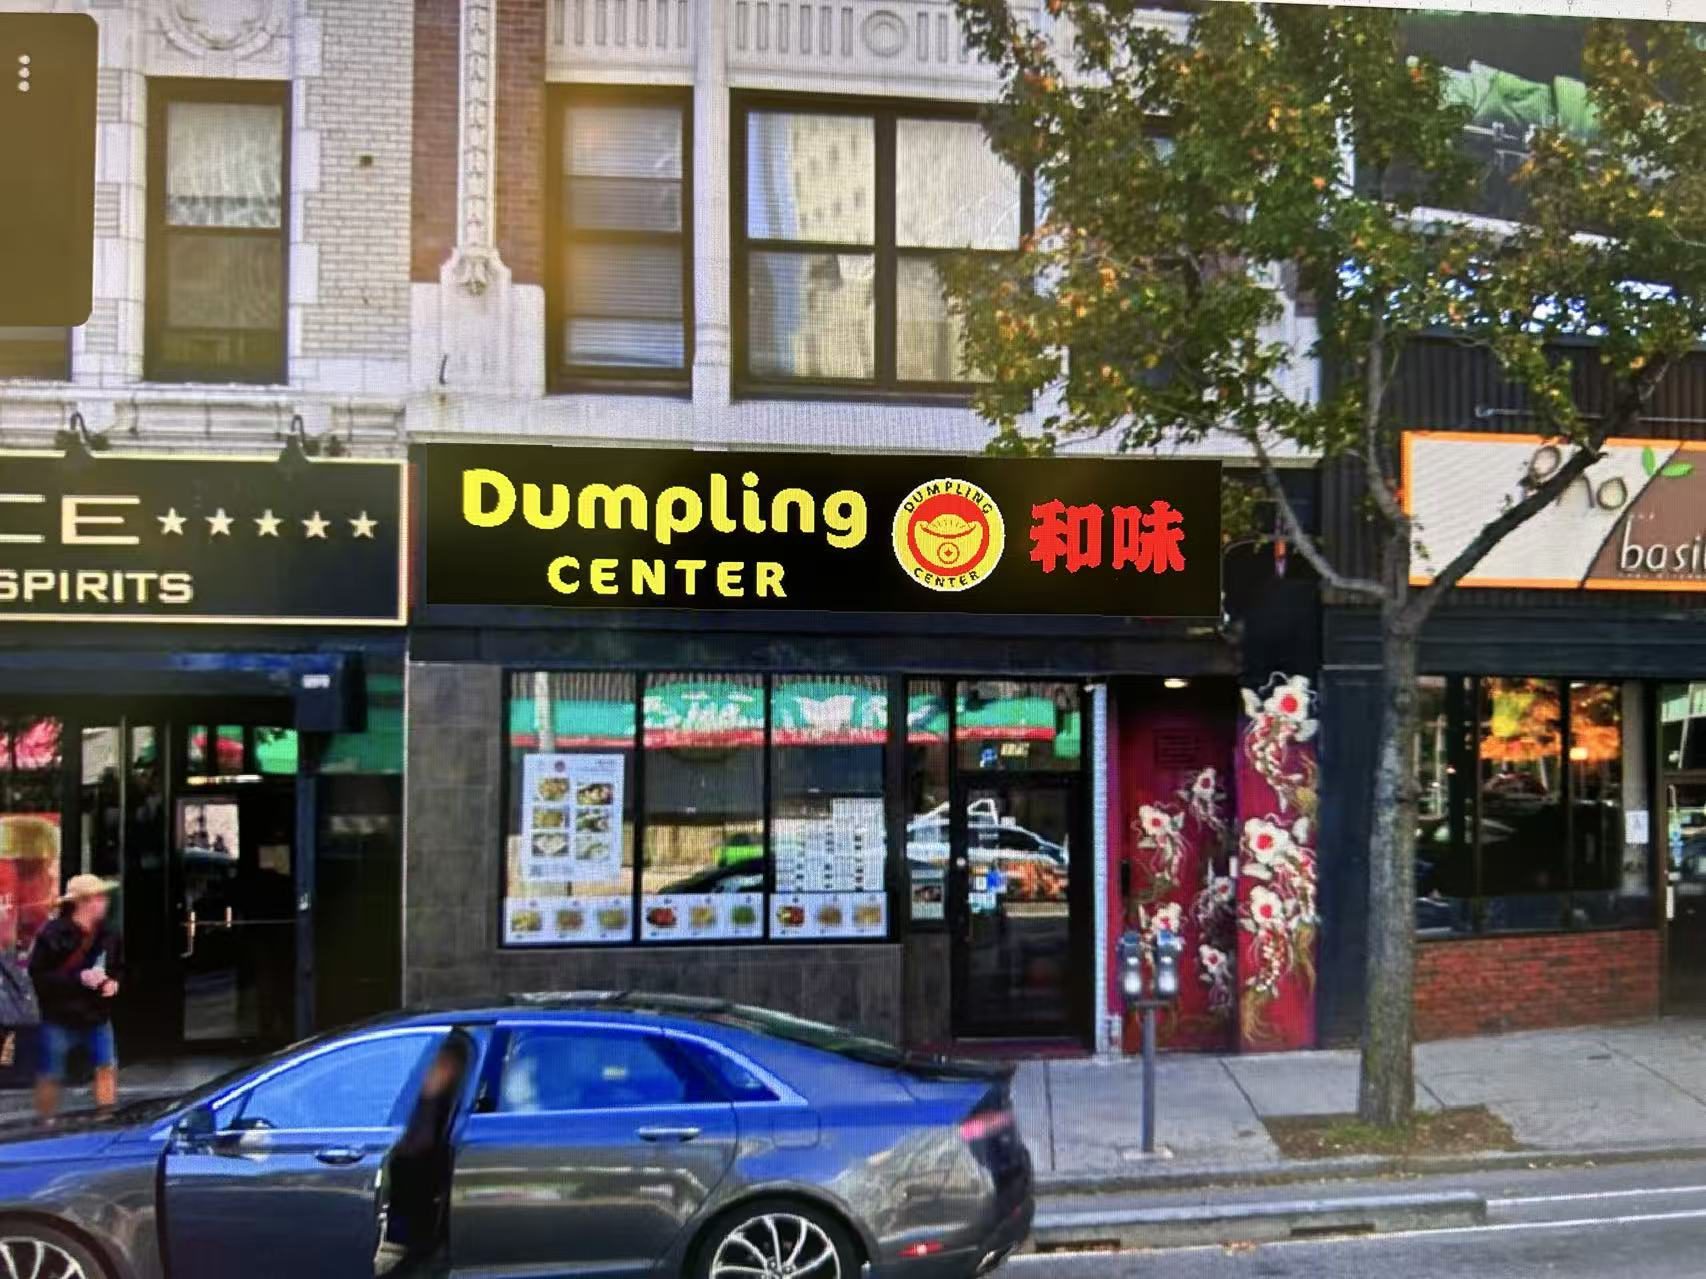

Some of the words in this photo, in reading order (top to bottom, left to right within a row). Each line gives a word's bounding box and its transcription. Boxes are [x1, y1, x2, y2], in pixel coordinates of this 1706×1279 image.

[463, 469, 867, 549] Dumpling
[904, 481, 993, 514] DUMPLING
[1030, 499, 1184, 573] 和味
[1621, 514, 1706, 572] basi
[547, 556, 787, 597] CENTER
[913, 567, 980, 587] CENTER
